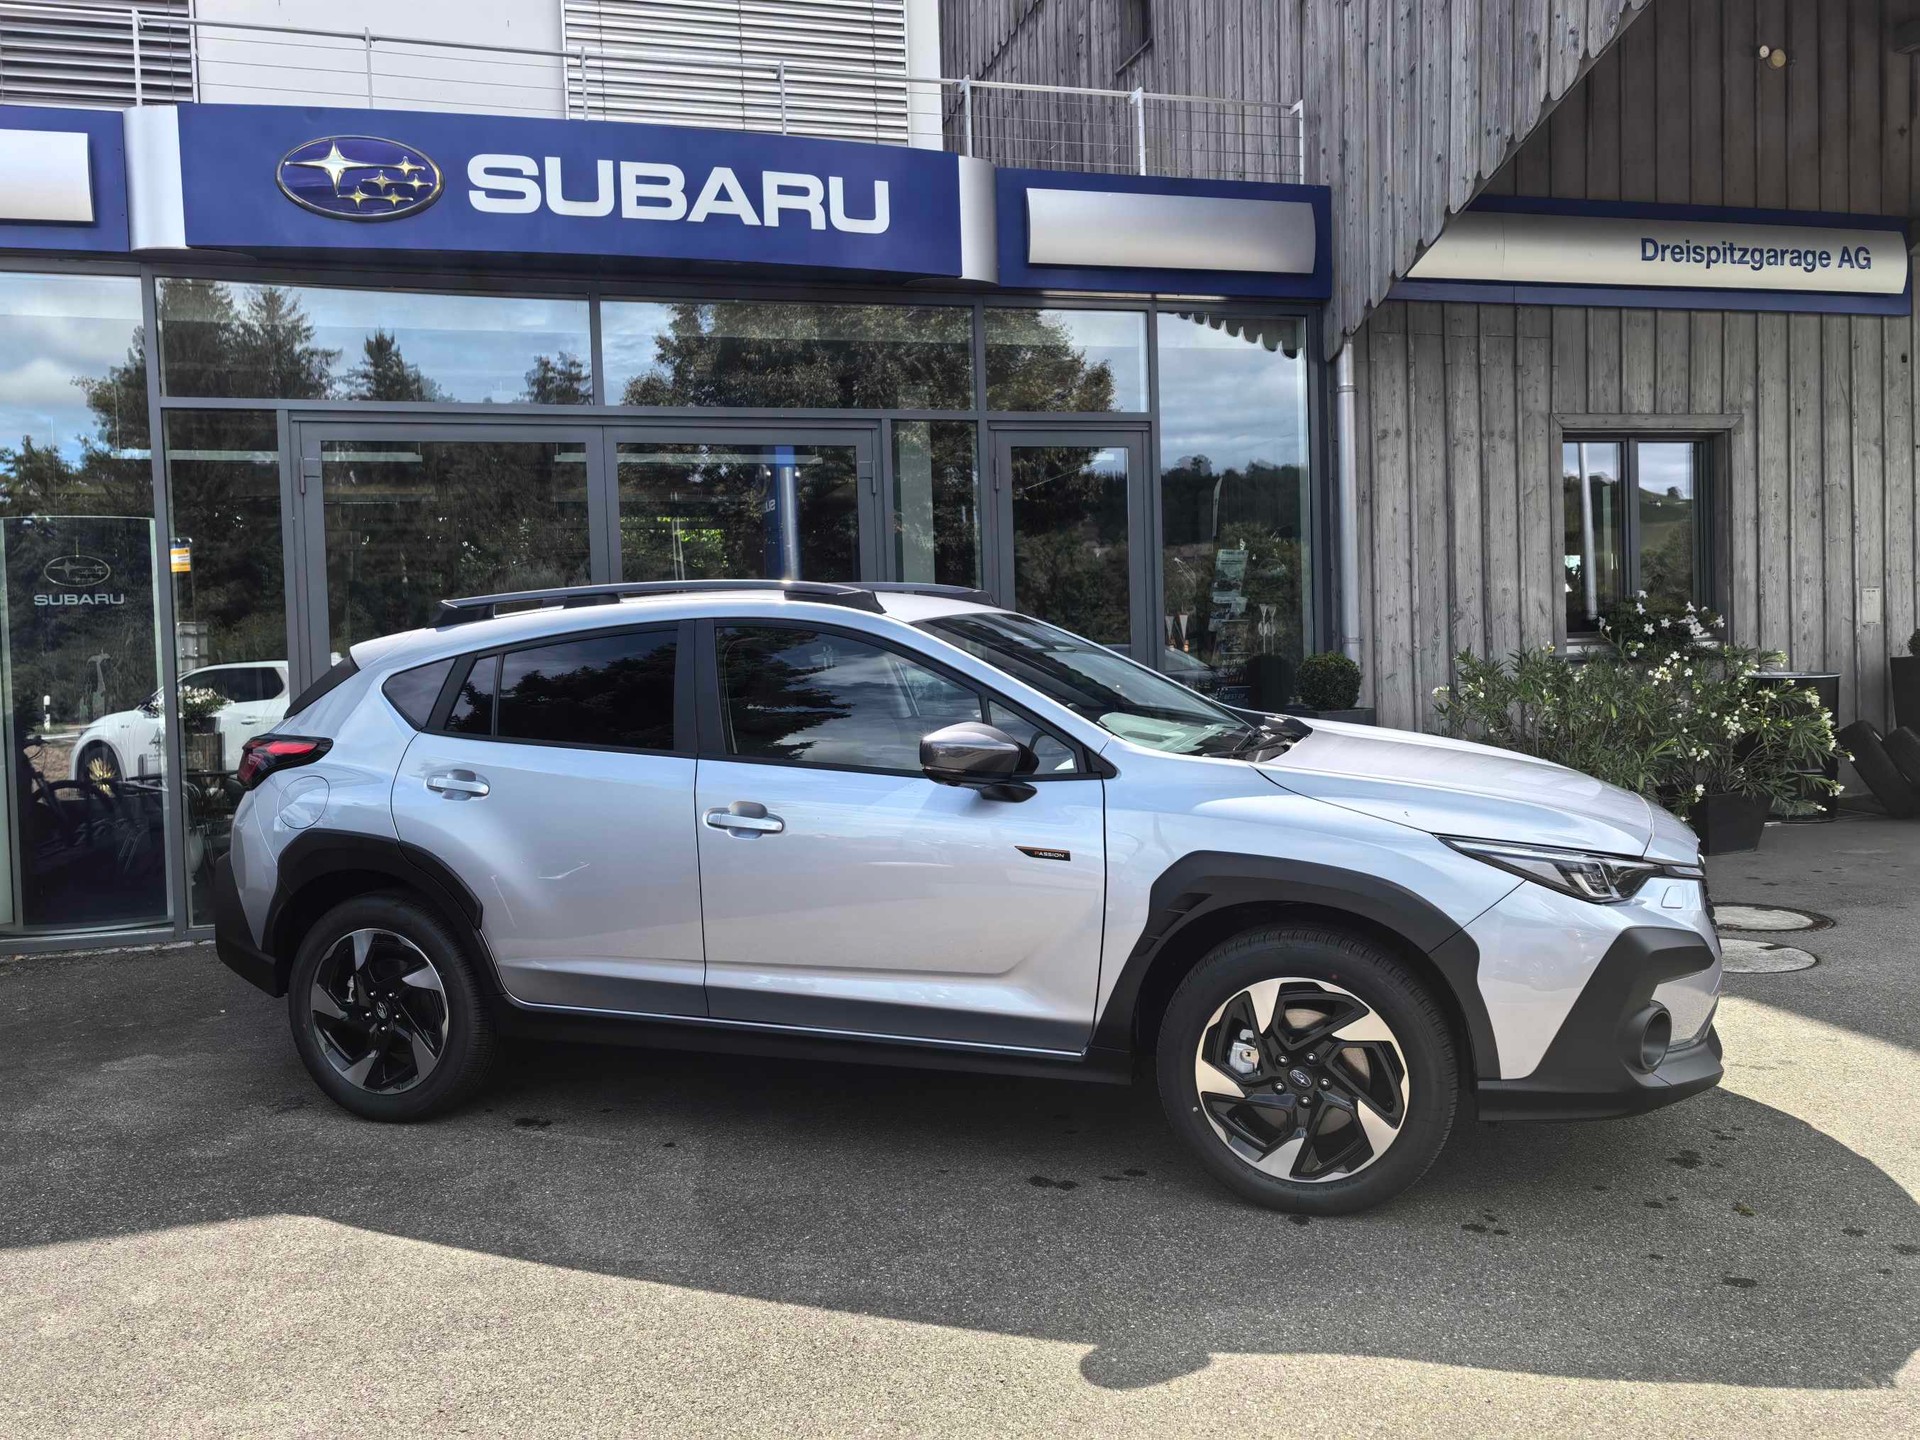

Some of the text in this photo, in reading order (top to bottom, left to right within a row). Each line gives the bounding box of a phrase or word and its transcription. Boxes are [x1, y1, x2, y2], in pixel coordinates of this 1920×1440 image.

[467, 153, 890, 235] SUBARU
[1640, 237, 1872, 273] Dreispitzgarage AG
[33, 593, 125, 606] SUBARU
